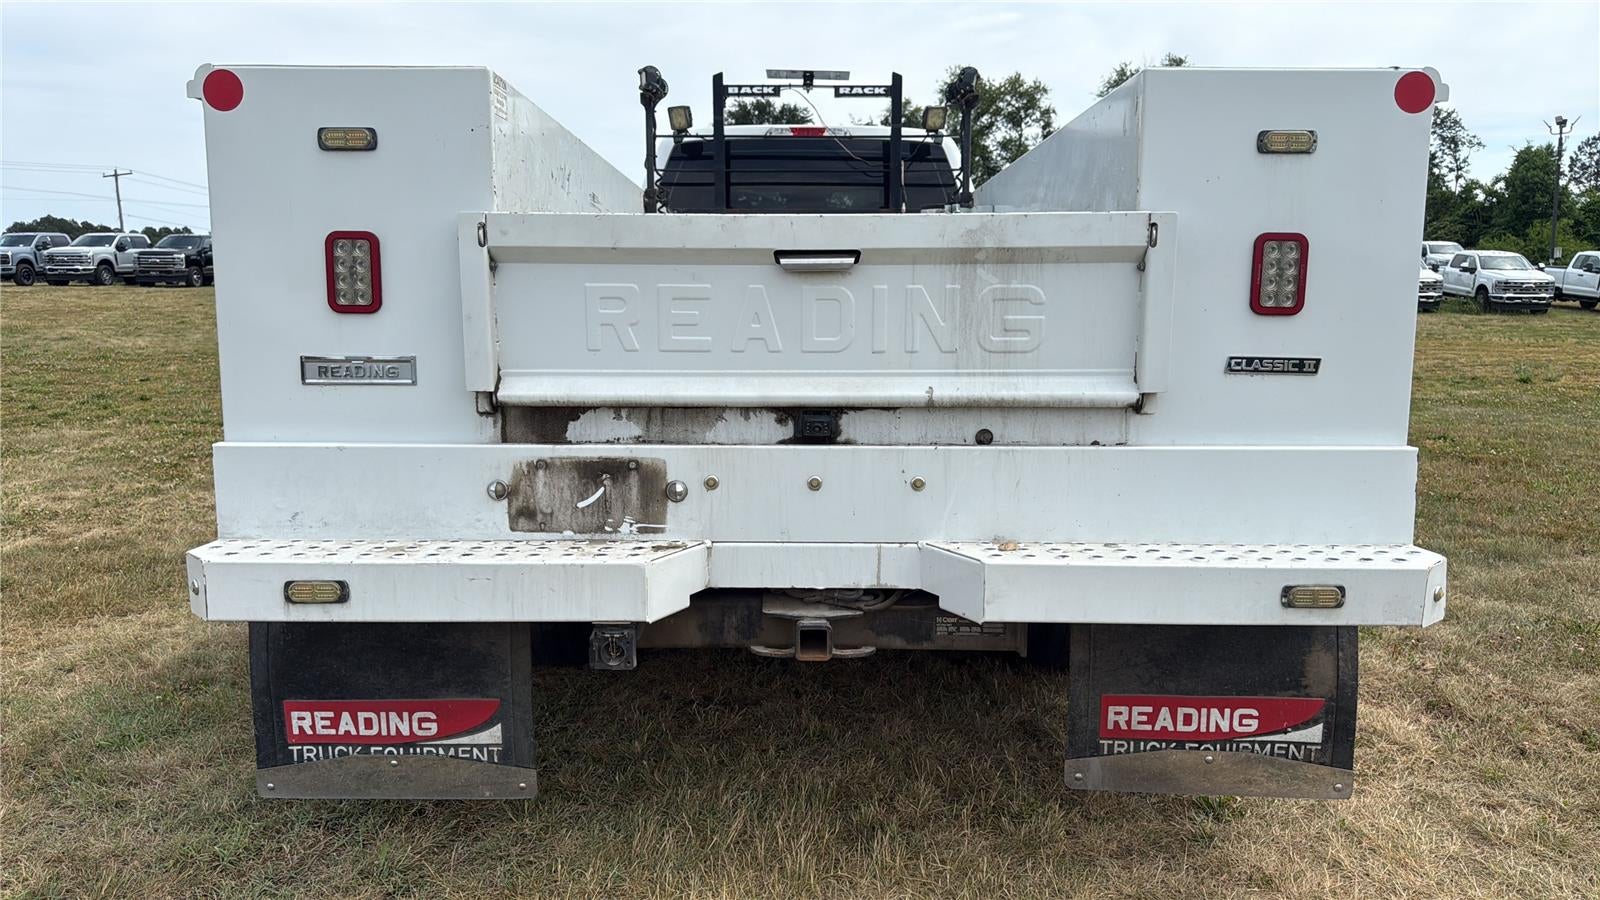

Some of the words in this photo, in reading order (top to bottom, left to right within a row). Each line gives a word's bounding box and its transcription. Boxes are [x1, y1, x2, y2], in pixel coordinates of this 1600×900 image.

[727, 86, 775, 94] BACK
[838, 87, 888, 95] RACK
[584, 283, 1046, 353] READING
[317, 365, 400, 378] READING
[1230, 359, 1300, 372] CLASSIC
[1303, 360, 1317, 372] II
[290, 711, 438, 737] READING
[1107, 705, 1260, 733] READING
